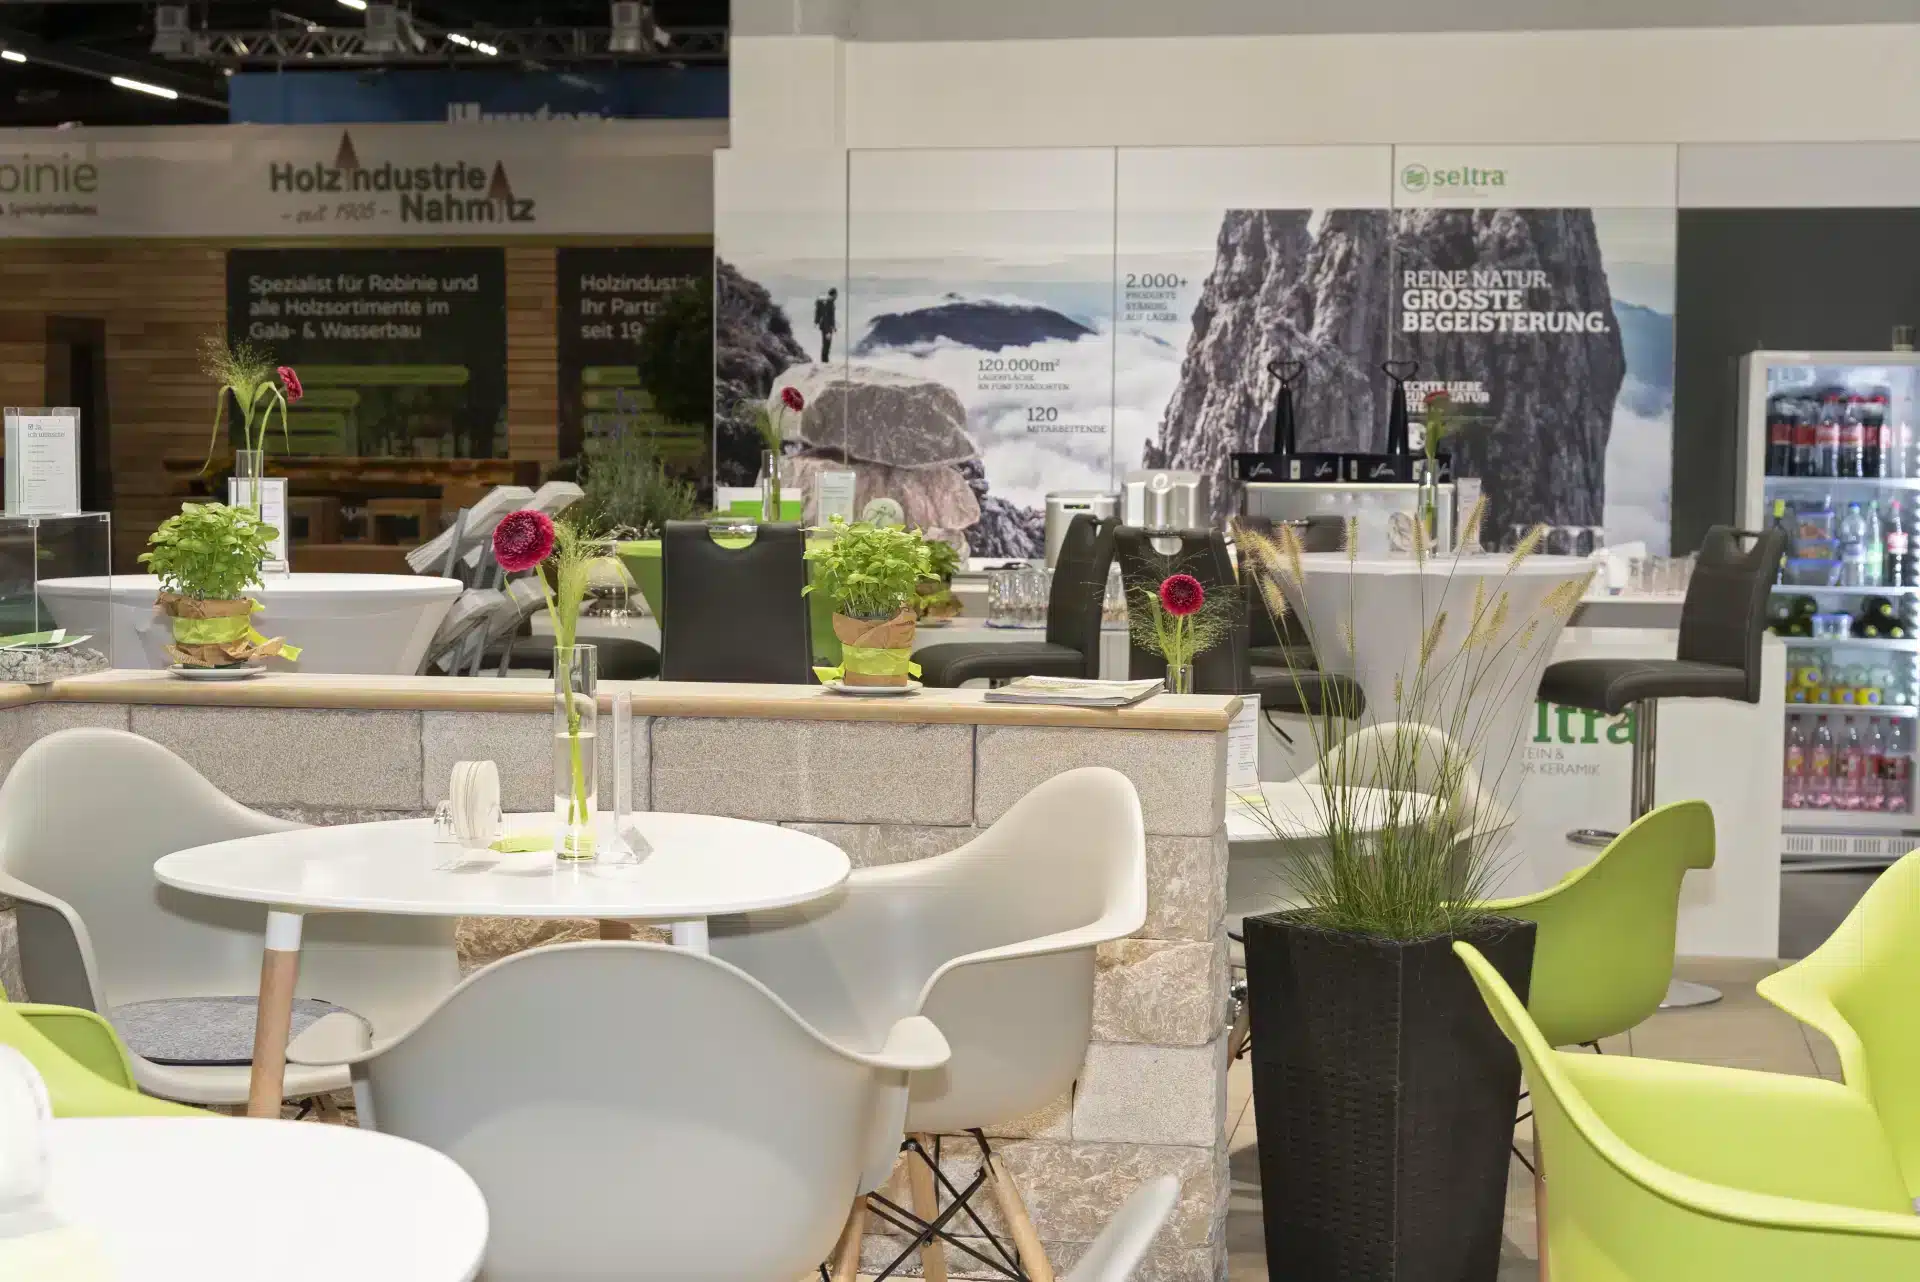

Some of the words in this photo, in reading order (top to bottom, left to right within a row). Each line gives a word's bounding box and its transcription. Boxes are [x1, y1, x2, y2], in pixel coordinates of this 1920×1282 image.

[1433, 167, 1505, 187] seltra
[249, 274, 332, 296] Spezialist
[337, 274, 364, 292] für
[368, 274, 437, 292] Robinie
[442, 274, 479, 292] und
[1125, 273, 1188, 289] 2.000+
[1403, 270, 1467, 289] REINE
[1472, 270, 1552, 288] NATUR.
[249, 298, 280, 316] alle
[285, 298, 422, 316] Holzsortimente
[426, 298, 450, 315] im
[581, 298, 606, 315] Ihr
[611, 298, 656, 316] Part
[303, 322, 316, 339] &
[321, 322, 422, 340] Wasserbau
[581, 321, 614, 339] seit
[620, 321, 644, 341] 19
[1402, 311, 1611, 333] BEGEISTERUNG.
[1447, 381, 1484, 391] LIEBE
[1027, 407, 1058, 422] 120
[1533, 701, 1636, 744] ltra
[1521, 747, 1551, 759] TEIN
